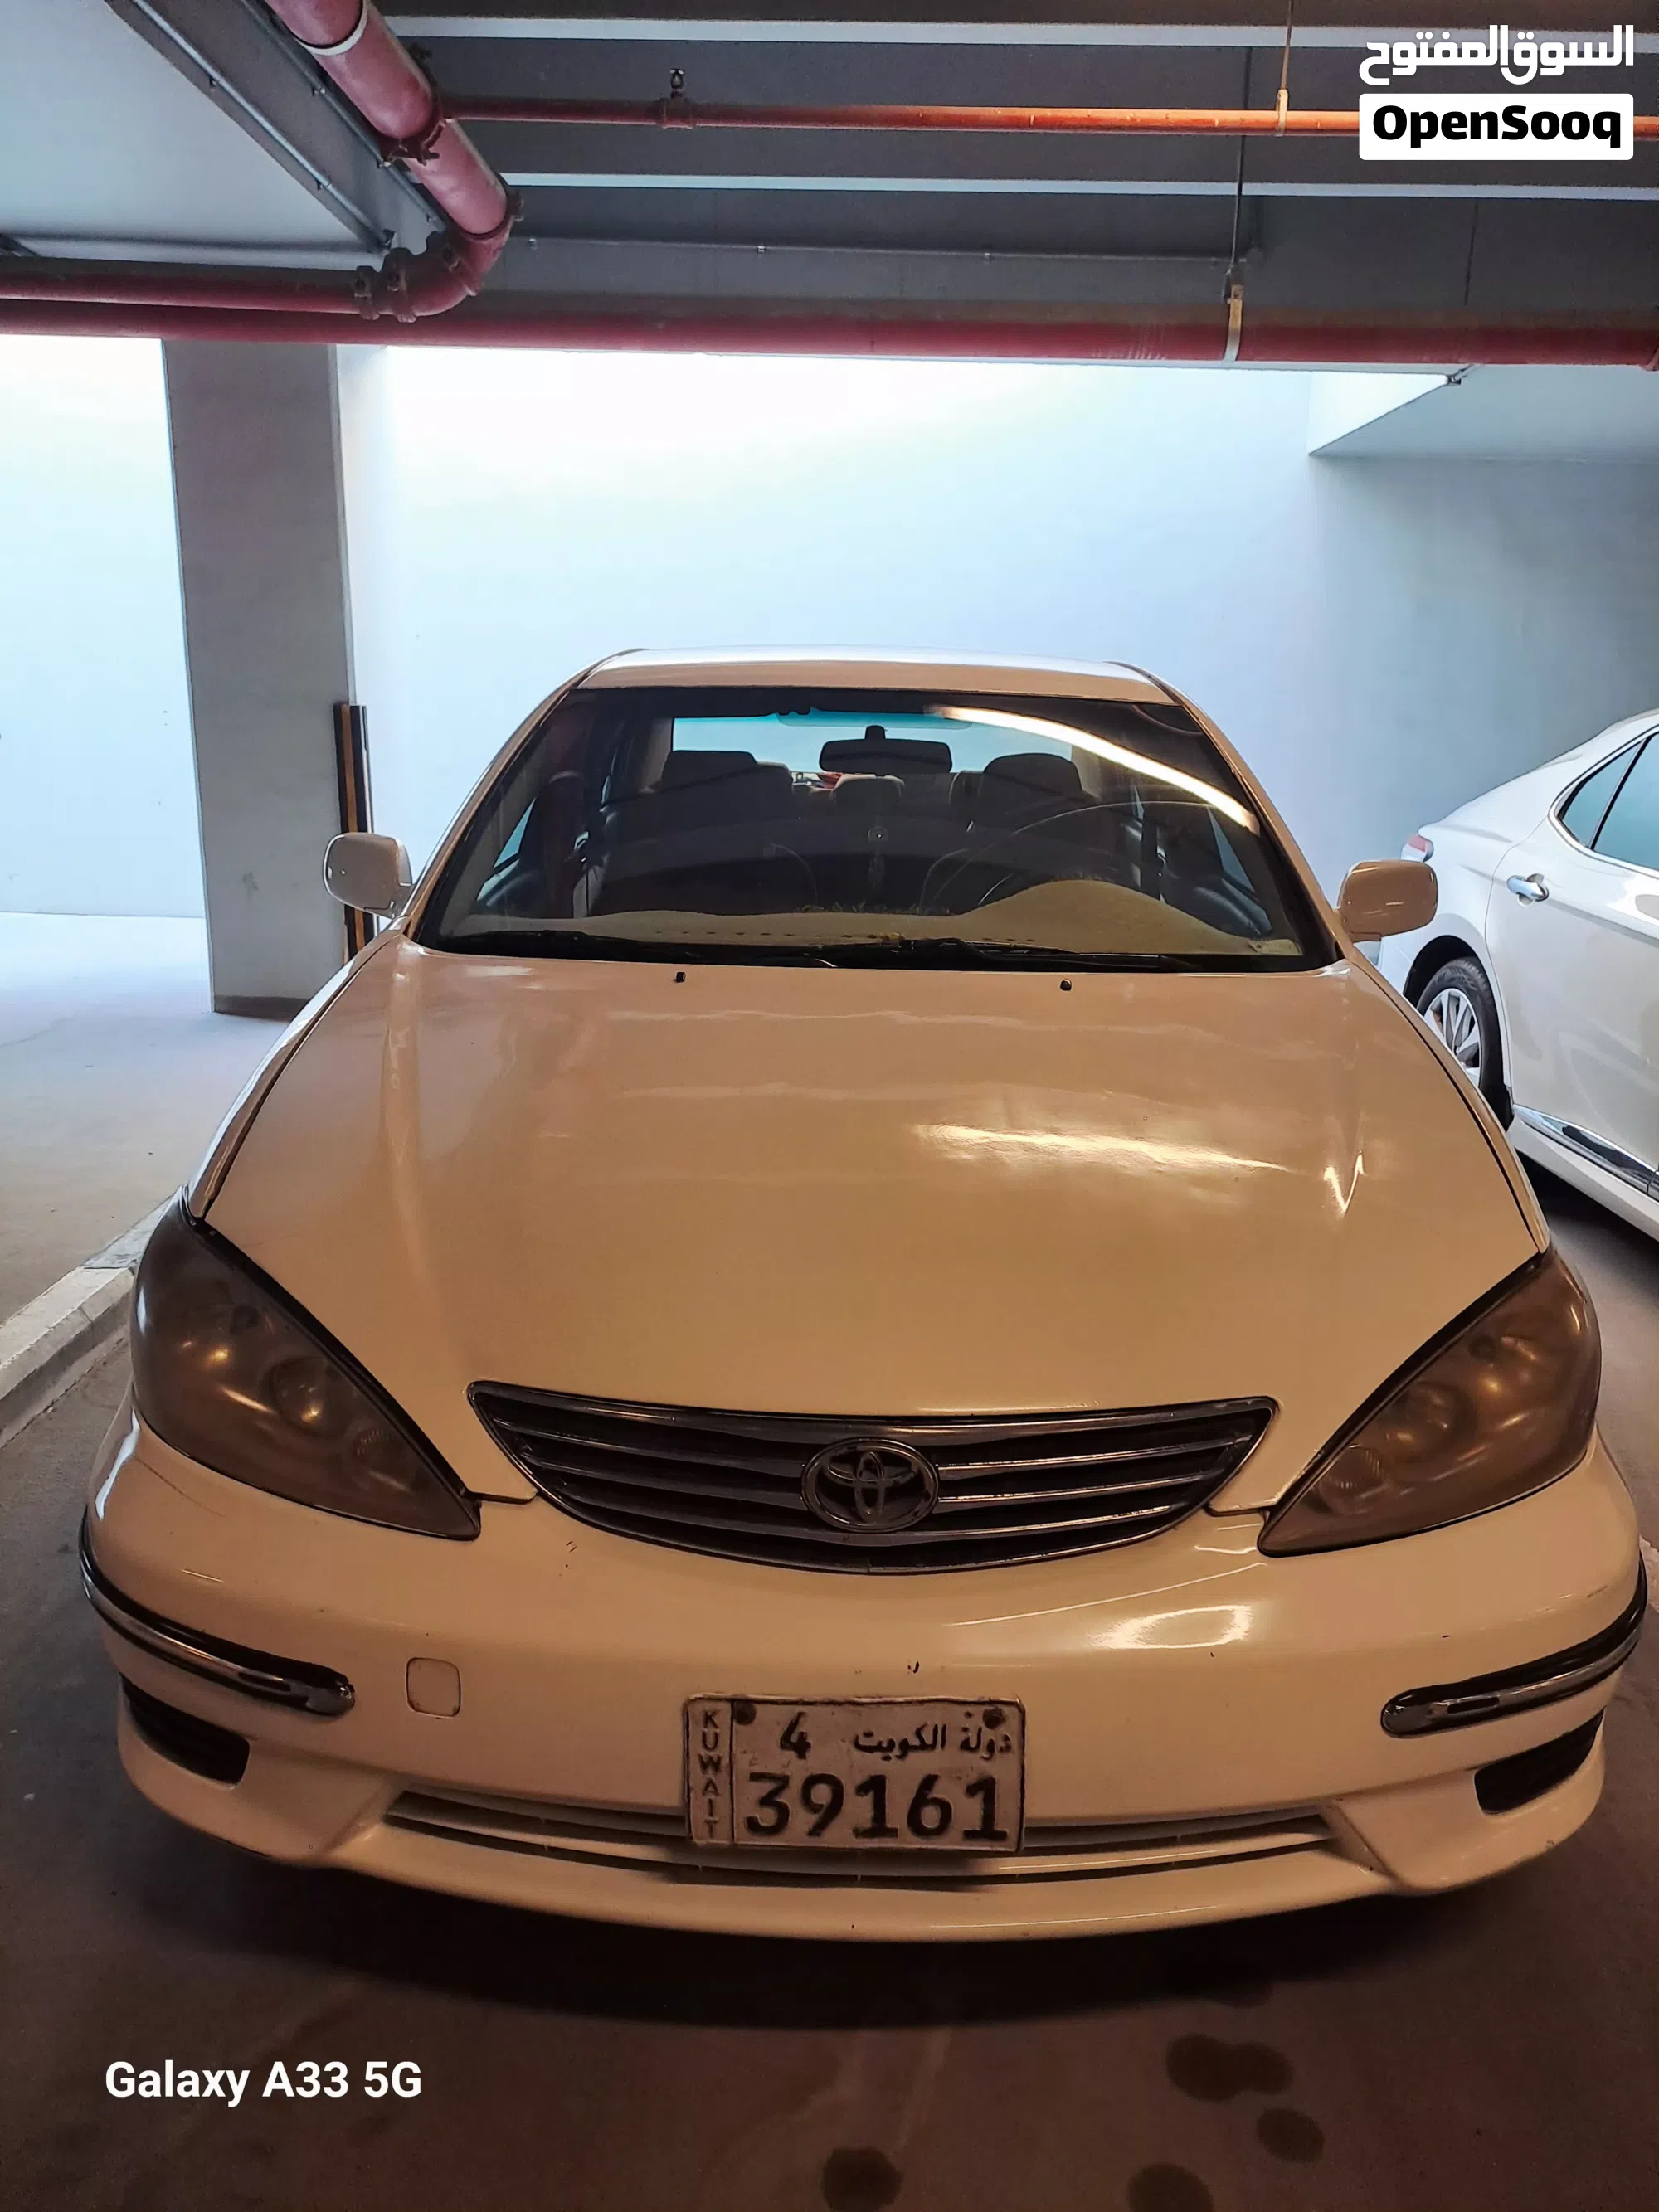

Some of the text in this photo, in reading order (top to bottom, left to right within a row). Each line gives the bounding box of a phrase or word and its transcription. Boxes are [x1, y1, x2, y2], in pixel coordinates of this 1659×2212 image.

[779, 1711, 812, 1760] 4
[854, 1723, 1013, 1761] دولة الكويت
[698, 1711, 721, 1838] KUWAIT
[745, 1772, 1009, 1840] 39161
